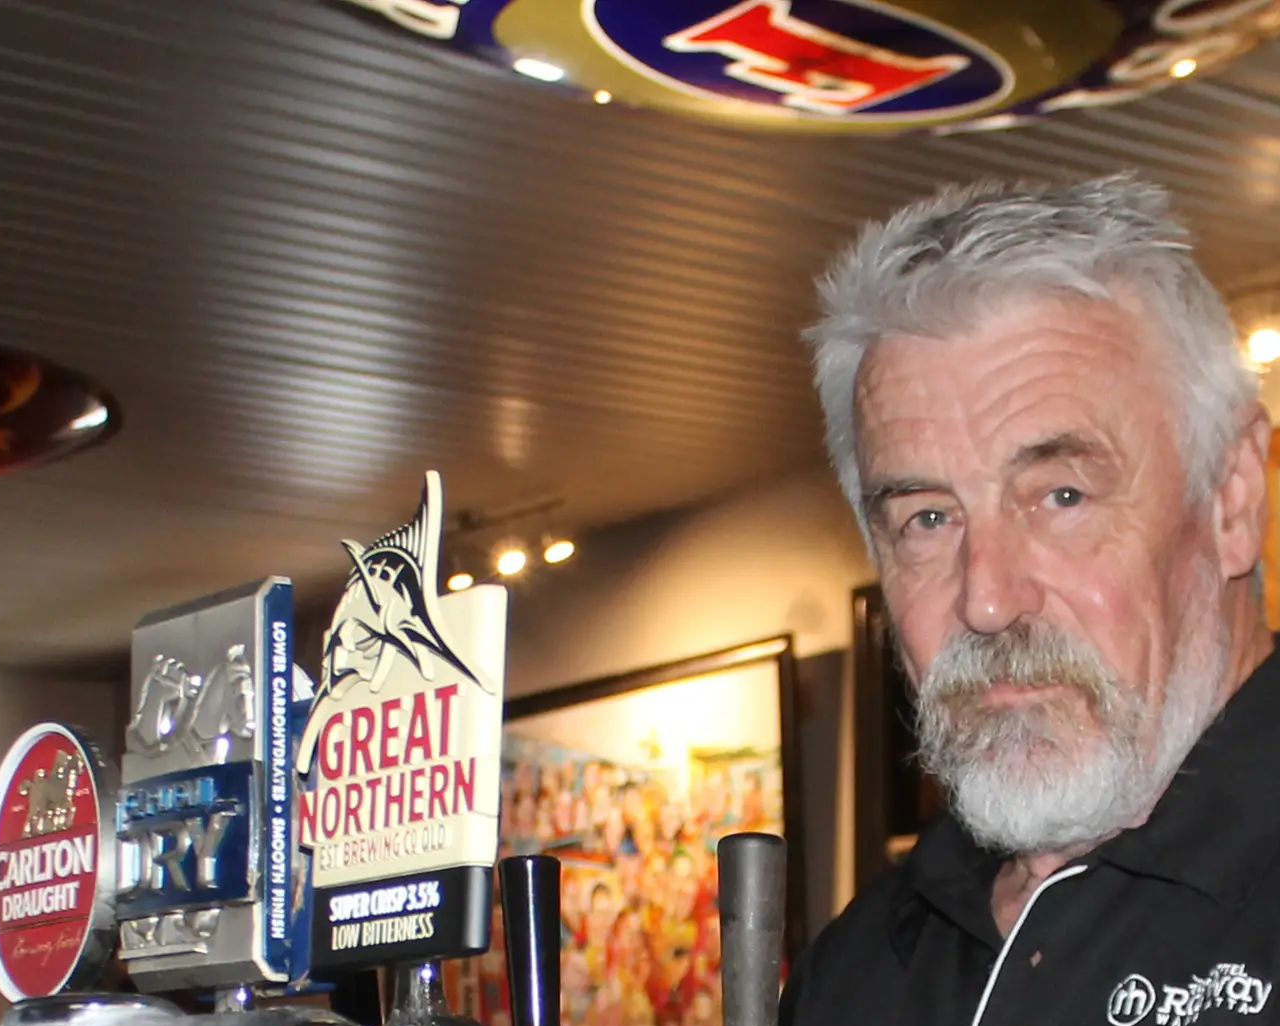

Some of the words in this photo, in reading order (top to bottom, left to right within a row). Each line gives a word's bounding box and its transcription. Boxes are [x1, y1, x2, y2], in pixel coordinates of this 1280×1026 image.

[272, 621, 287, 673] LOWER
[272, 676, 287, 801] CARBOHYDRATES
[320, 684, 458, 781] GREAT
[299, 757, 476, 844] NORTHERN
[272, 817, 286, 884] SMOOTH
[343, 830, 401, 867] BREWING
[2, 880, 80, 922] DRAUGHT
[272, 888, 286, 939] FINISH
[329, 891, 370, 922] SUPER
[370, 885, 408, 915] CRISP
[406, 880, 440, 911] 3.5%
[331, 922, 360, 951] LOW
[361, 912, 435, 947] BITTERNESS
